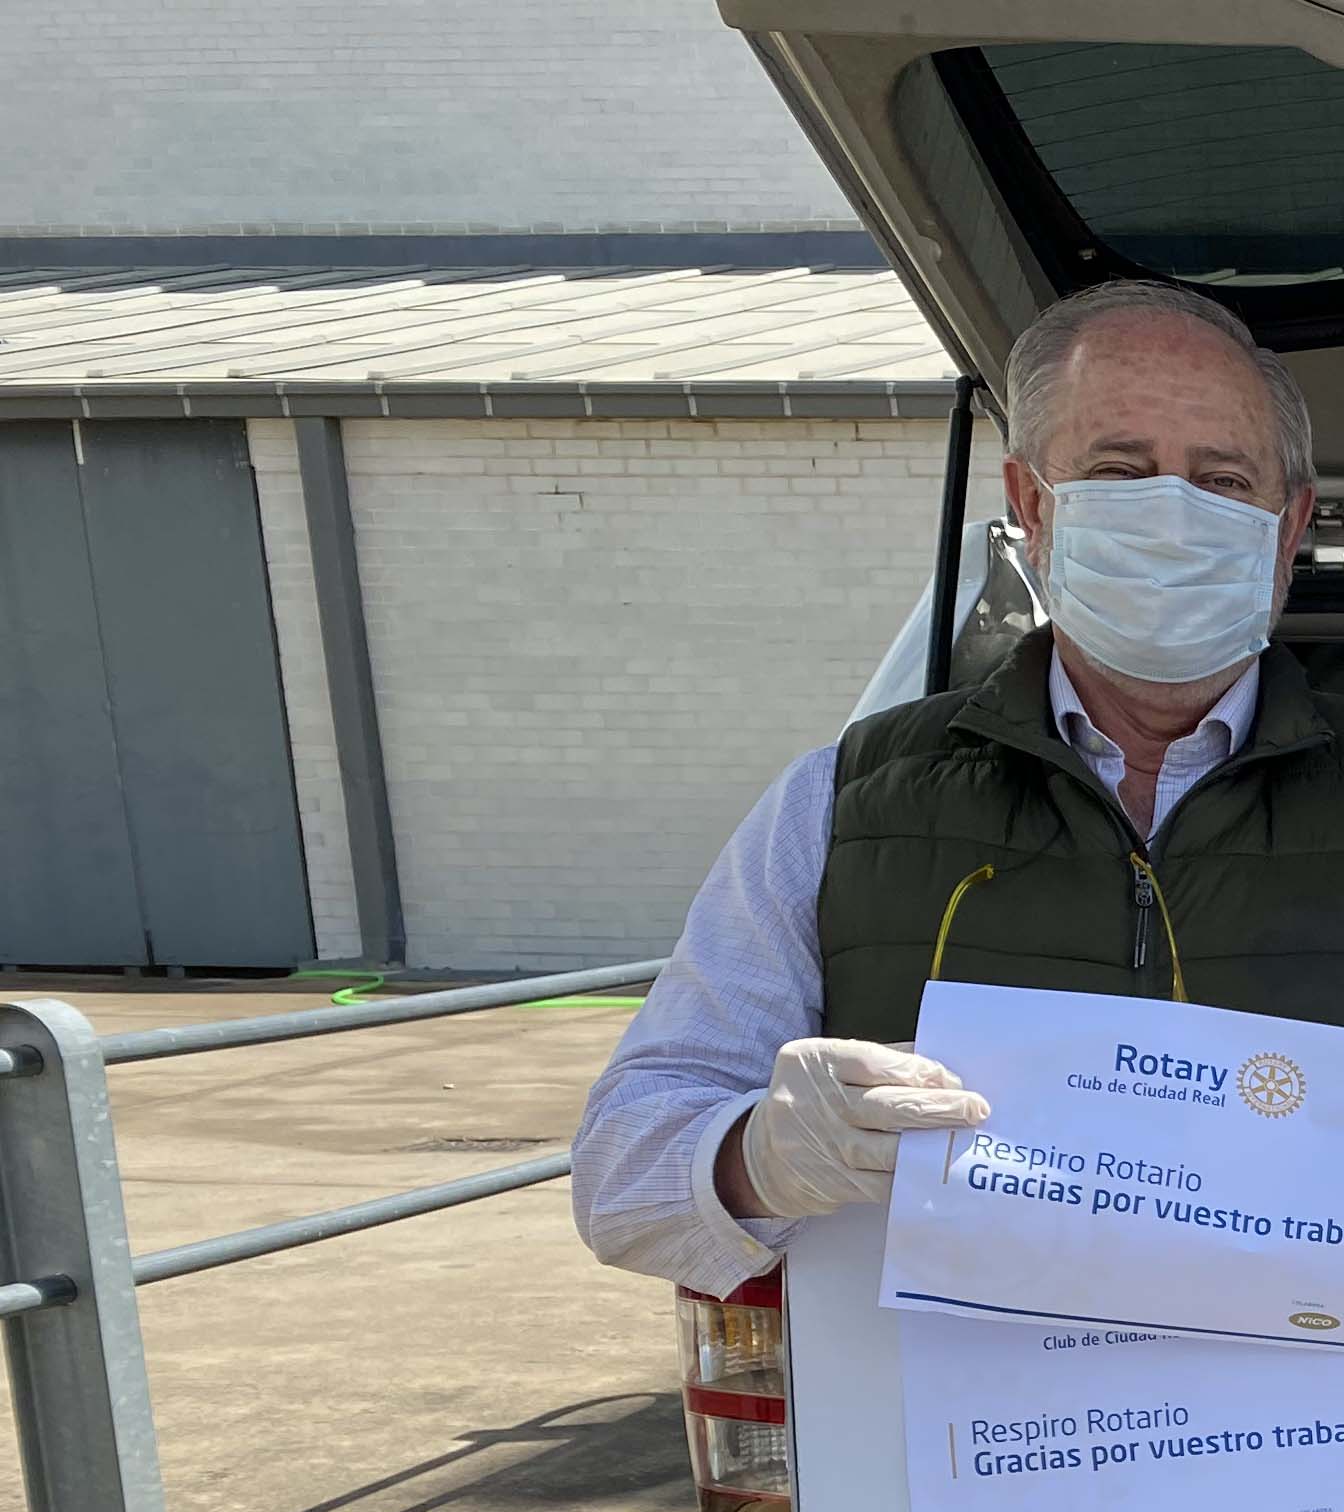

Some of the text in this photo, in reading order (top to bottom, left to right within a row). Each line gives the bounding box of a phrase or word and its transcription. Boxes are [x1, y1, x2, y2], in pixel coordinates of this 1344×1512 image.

[1068, 1074, 1226, 1107] Club de Ciudad Real
[1114, 1043, 1229, 1091] Rotary
[972, 1133, 1201, 1192] Respiro Rotario
[968, 1164, 1083, 1205] Gracias
[1092, 1189, 1146, 1215] por
[1155, 1198, 1272, 1236] vuestro
[1043, 1334, 1076, 1350] Club
[1081, 1333, 1100, 1346] de
[972, 1403, 1188, 1450] Respiro Rotario
[974, 1445, 1082, 1476] Gracias
[1091, 1441, 1139, 1471] por
[1148, 1431, 1263, 1459] vuestro
